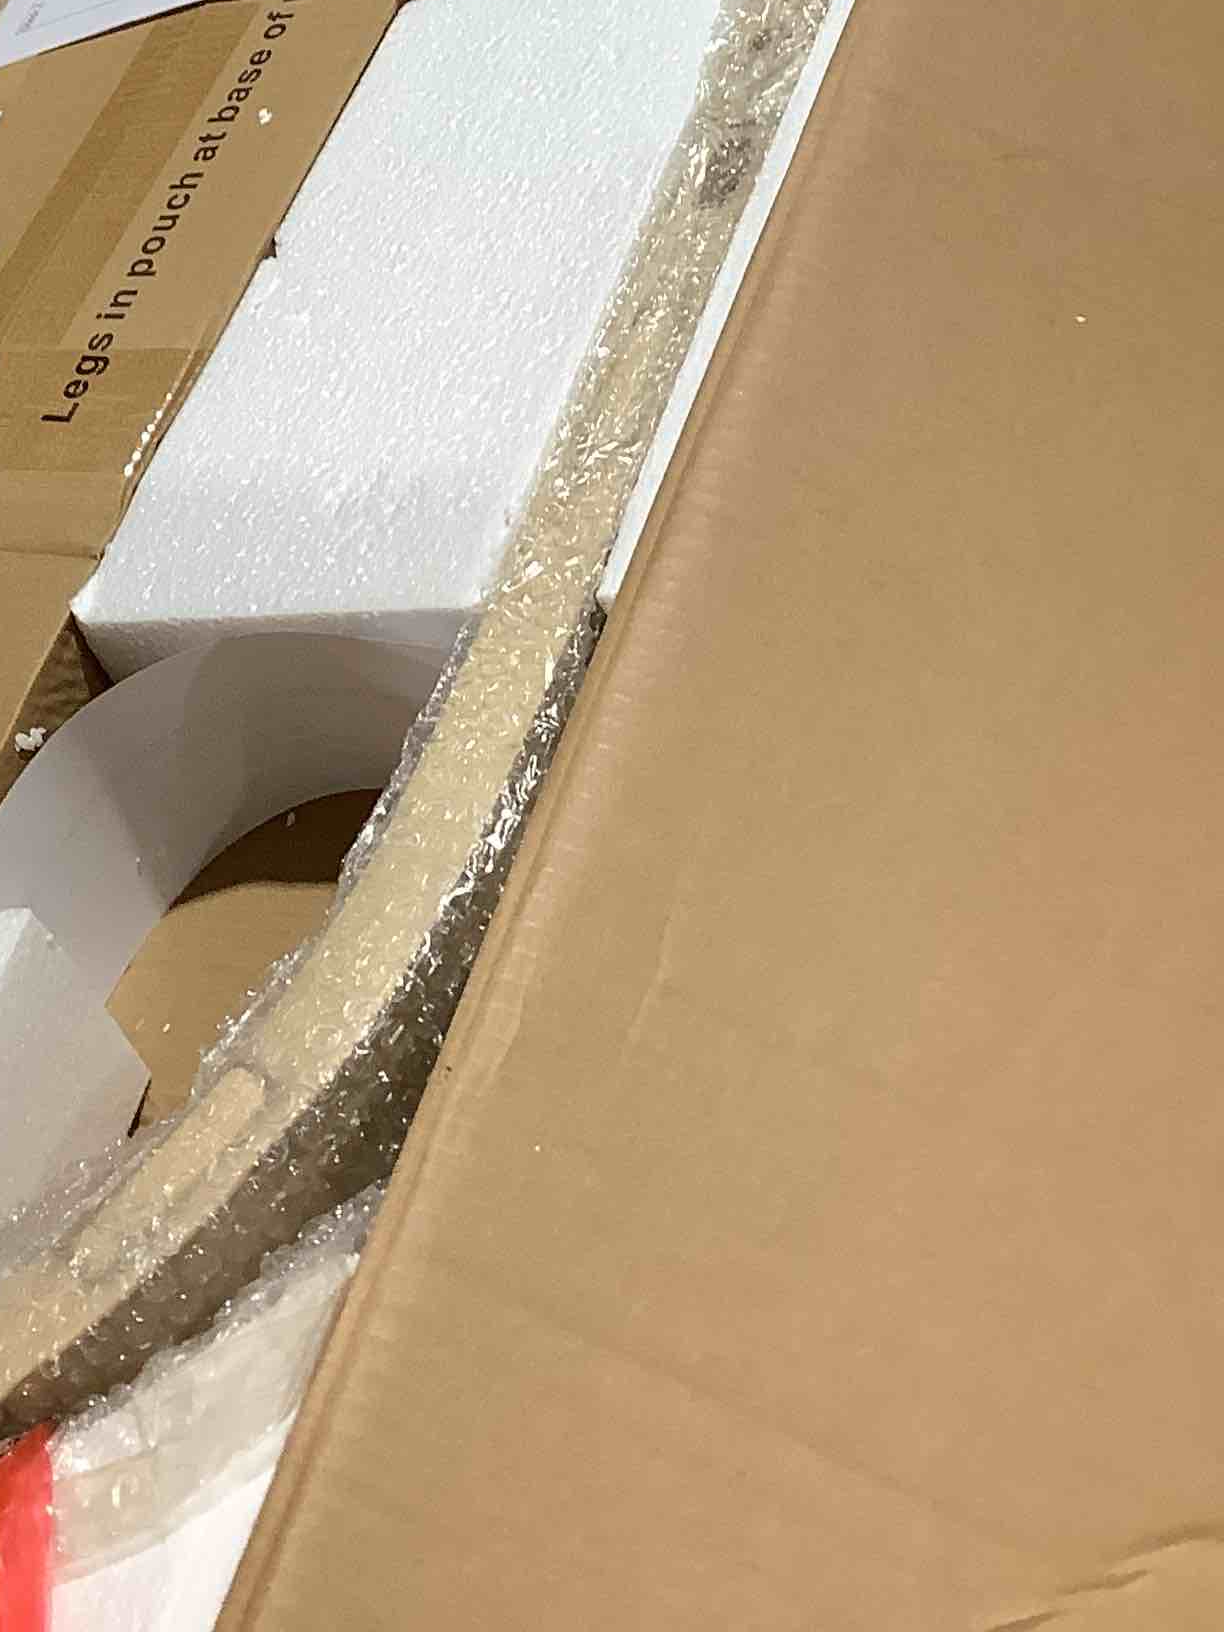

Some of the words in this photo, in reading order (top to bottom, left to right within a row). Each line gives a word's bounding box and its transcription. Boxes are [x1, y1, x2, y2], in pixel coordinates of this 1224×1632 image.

[263, 8, 296, 39] of
[208, 48, 272, 126] base
[192, 130, 227, 162] at
[127, 171, 204, 276] pouch
[96, 290, 138, 320] in
[42, 332, 114, 424] Legs
